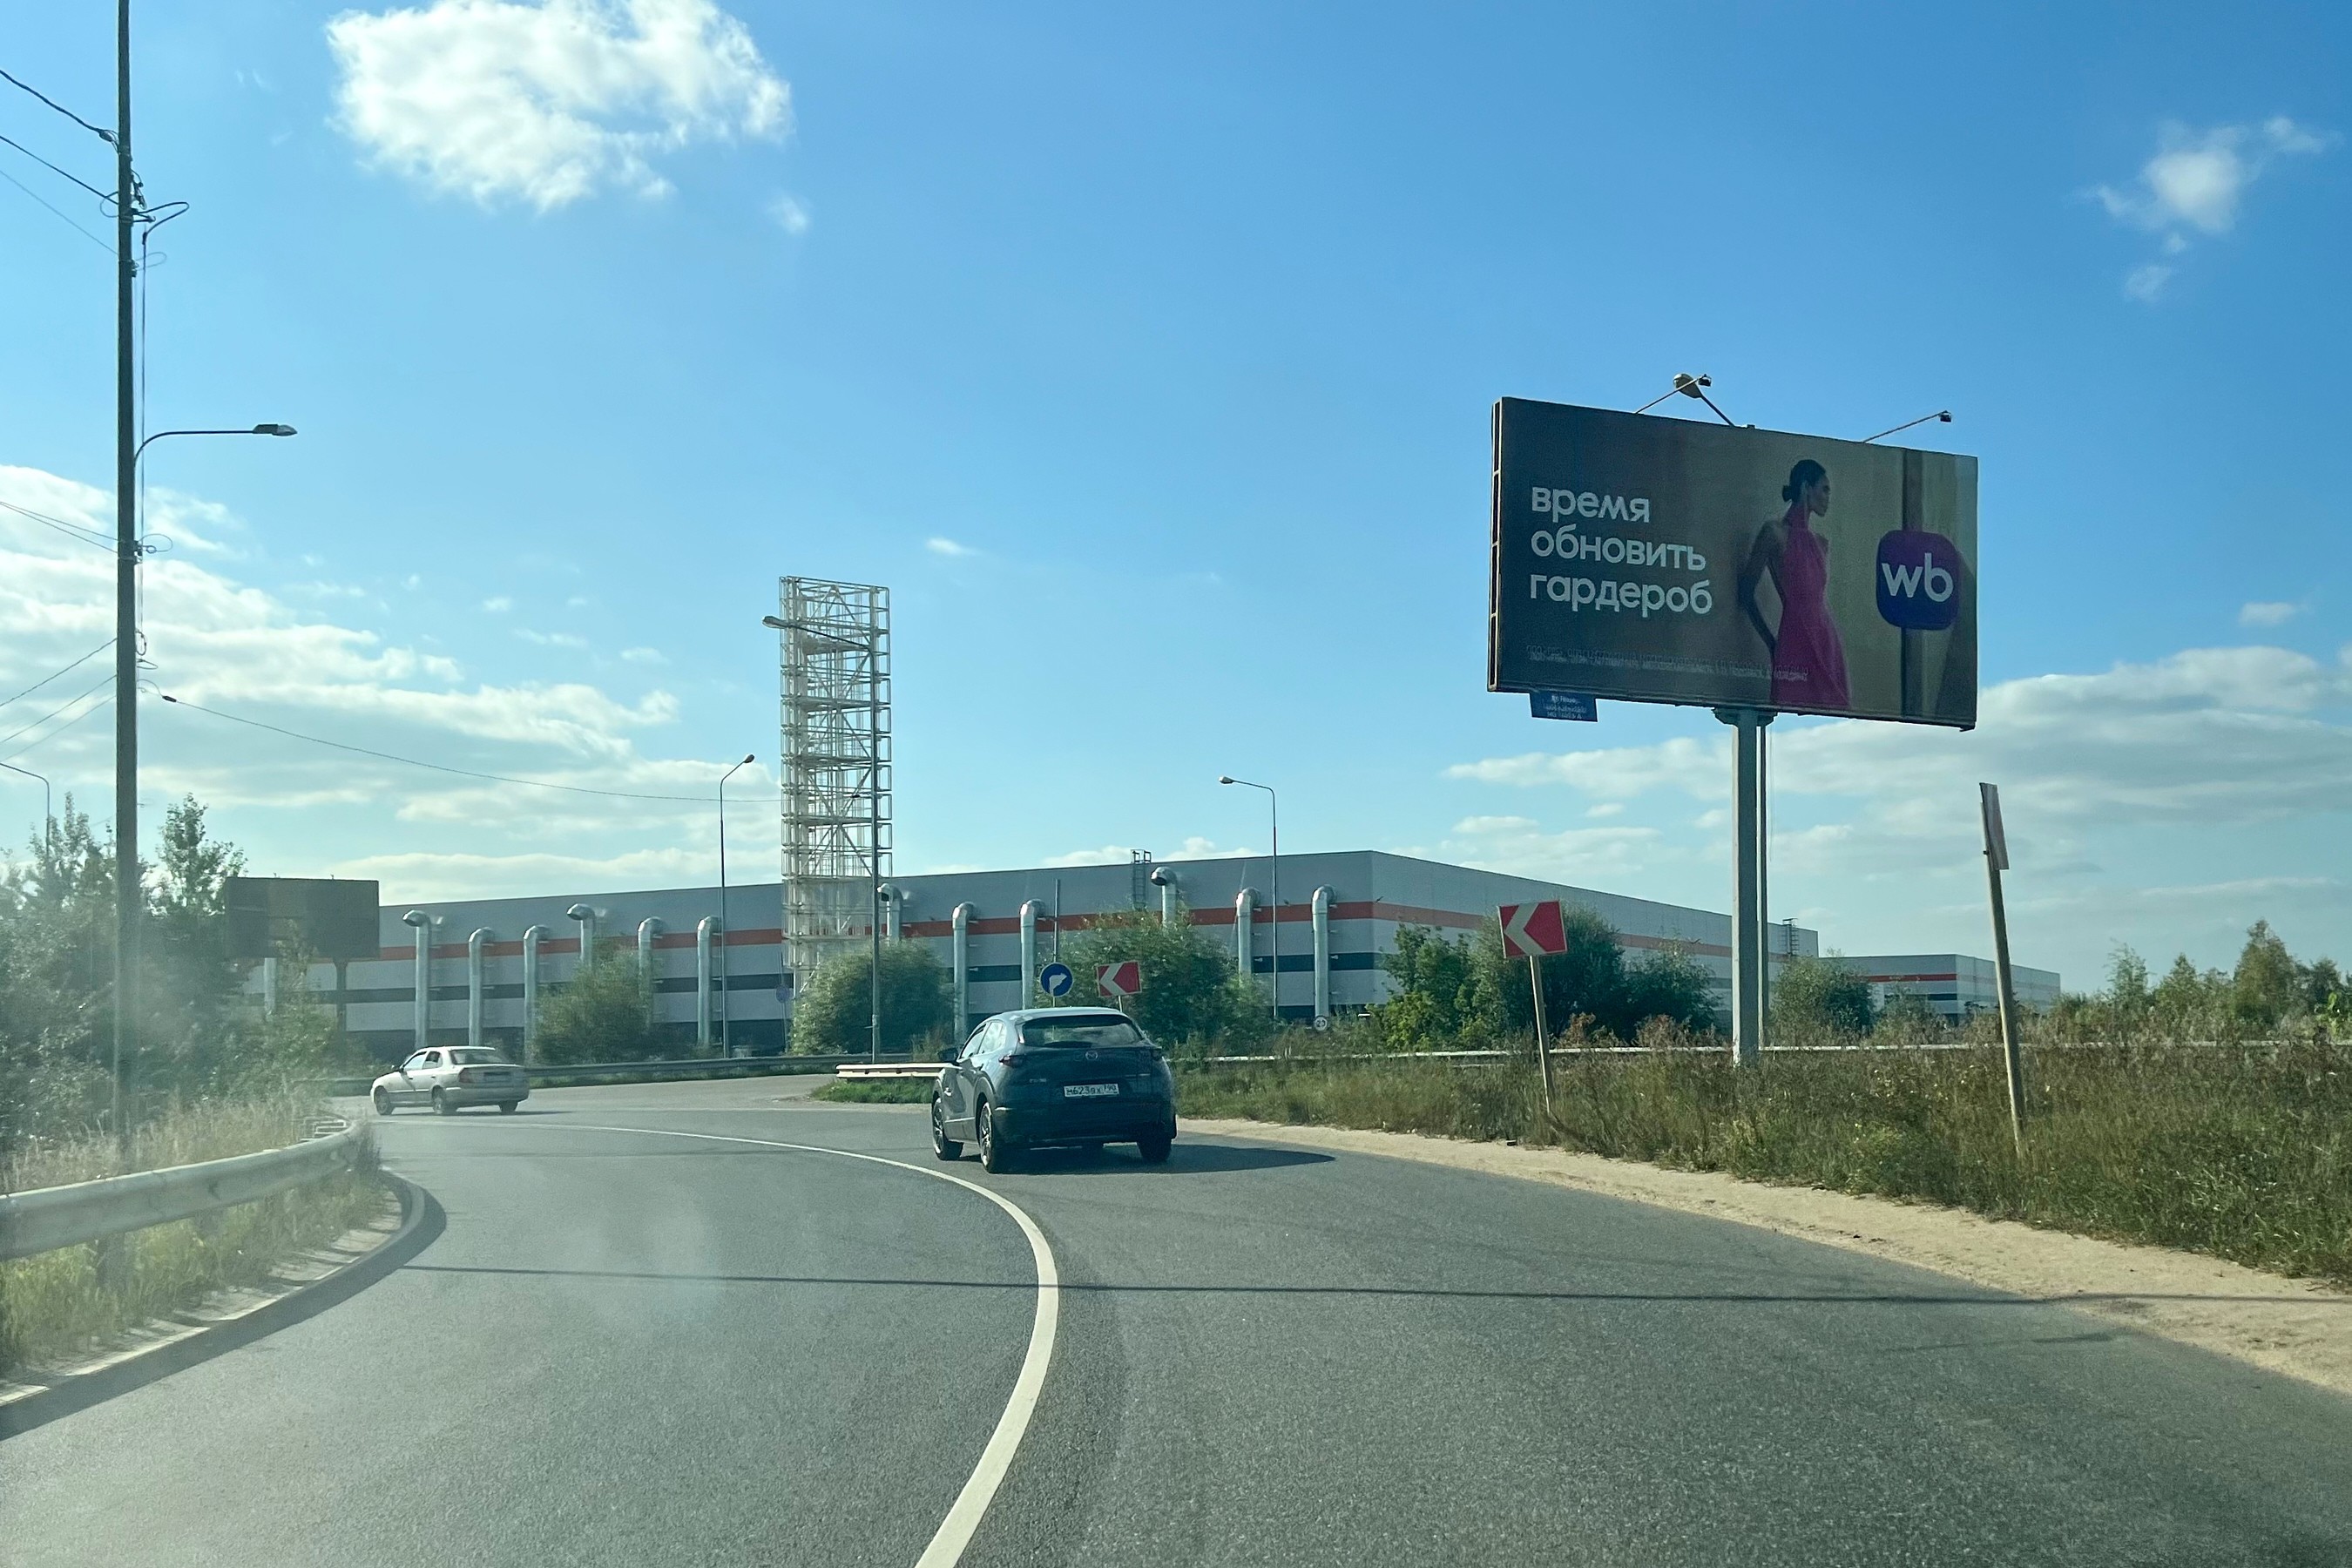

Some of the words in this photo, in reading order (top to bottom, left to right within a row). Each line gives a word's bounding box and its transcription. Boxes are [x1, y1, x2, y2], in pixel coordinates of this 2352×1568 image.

[1531, 486, 1650, 523] время
[1531, 524, 1707, 571] обновить
[1530, 574, 1713, 618] гардероб
[1882, 552, 1954, 602] wb
